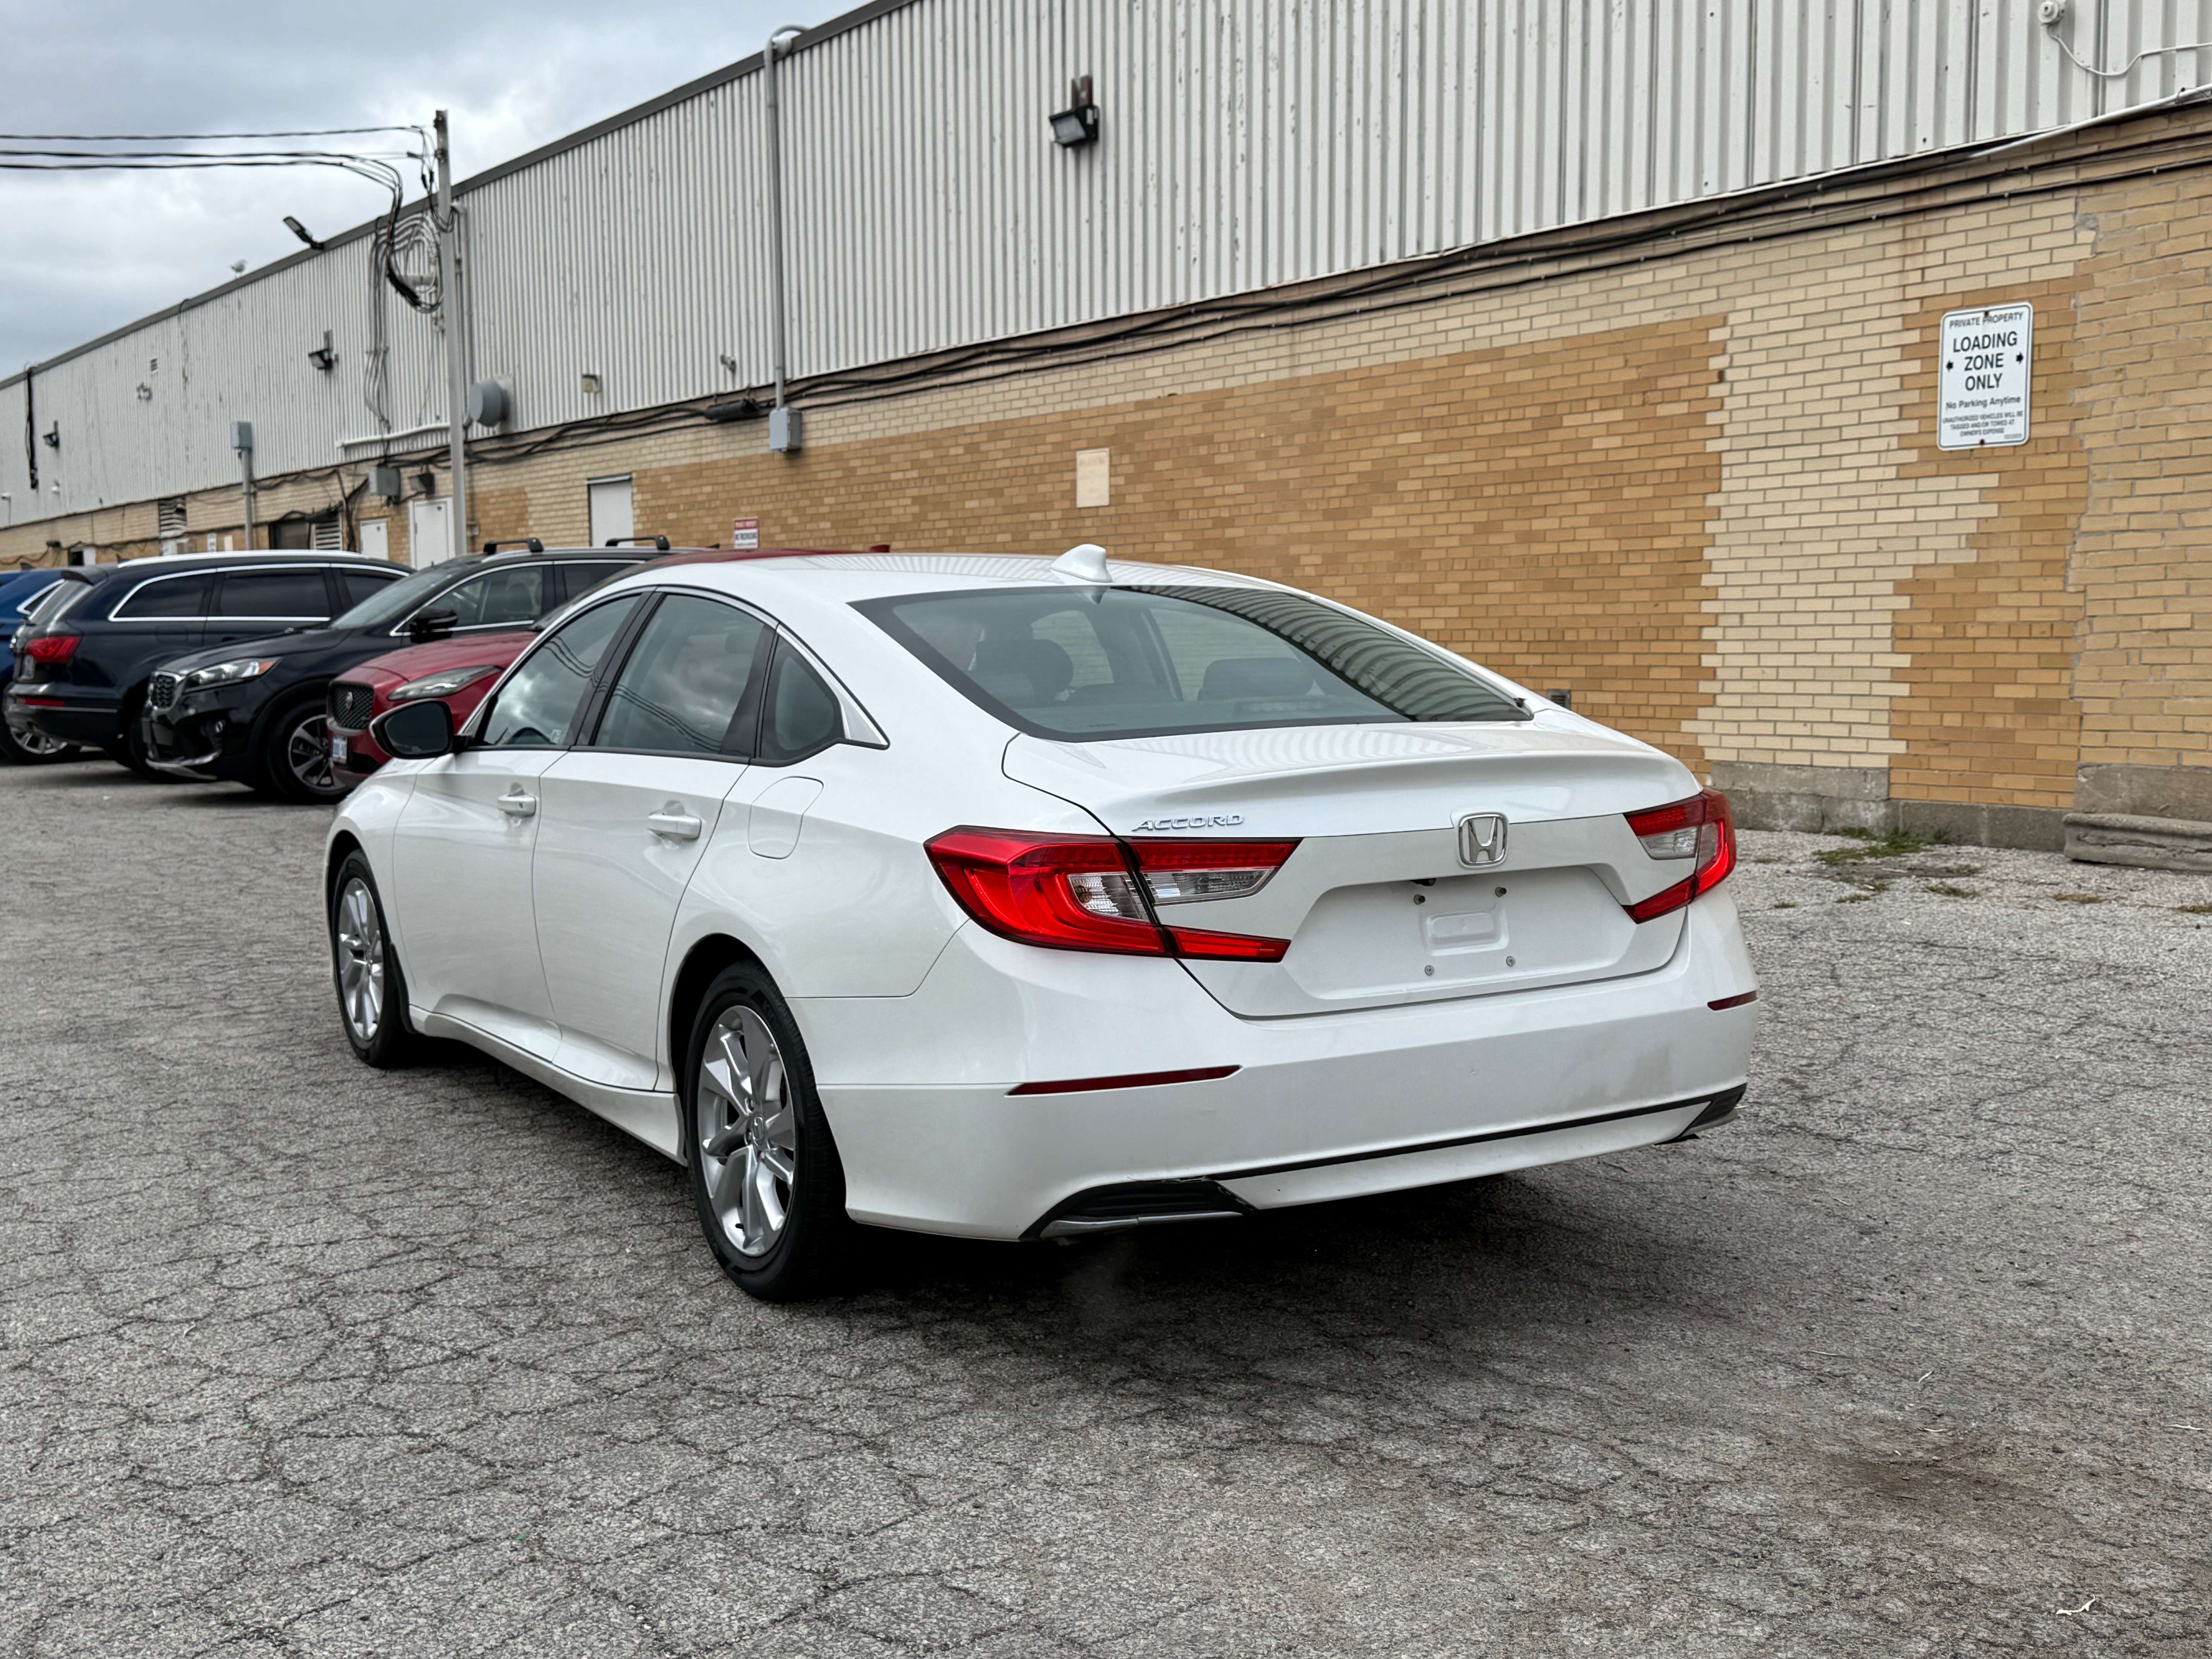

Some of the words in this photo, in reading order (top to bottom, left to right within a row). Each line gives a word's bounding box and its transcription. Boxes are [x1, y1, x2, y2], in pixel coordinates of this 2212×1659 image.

[1949, 317, 1980, 328] PRIVATE
[1982, 312, 2023, 325] PROPERTY
[1953, 331, 2018, 352] LOADING
[1964, 353, 2004, 371] ZONE
[1965, 373, 2002, 391] ONLY
[1958, 399, 1987, 409] Parking
[1989, 396, 2021, 406] Anytime
[1131, 814, 1244, 831] ACCORD
